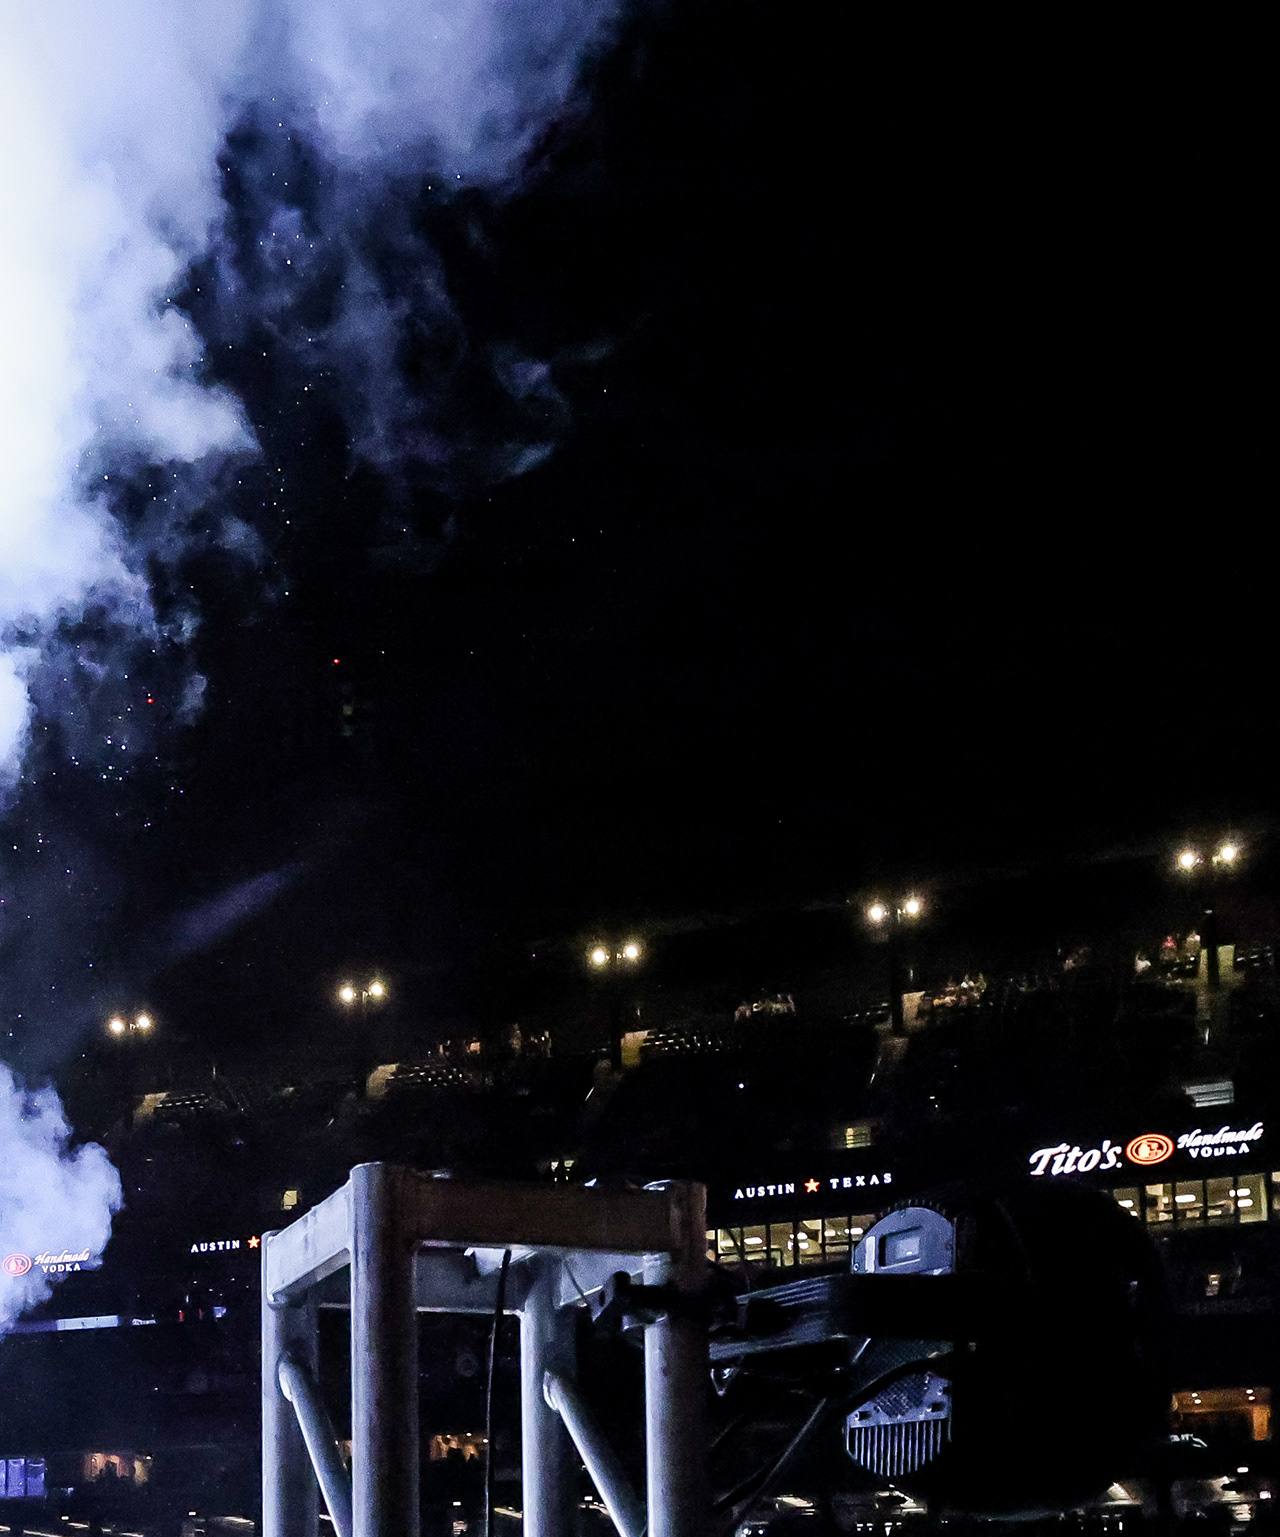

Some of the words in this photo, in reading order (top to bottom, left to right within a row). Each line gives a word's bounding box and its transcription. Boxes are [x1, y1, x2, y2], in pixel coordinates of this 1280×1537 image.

[1028, 1139, 1123, 1176] Tito's
[1177, 1121, 1264, 1149] Handmade
[734, 1182, 795, 1200] AUSTIN
[829, 1172, 892, 1190] TEXAS
[190, 1239, 240, 1254] AUSTIN
[34, 1248, 90, 1265] Handmade
[41, 1263, 81, 1273] VODKA
